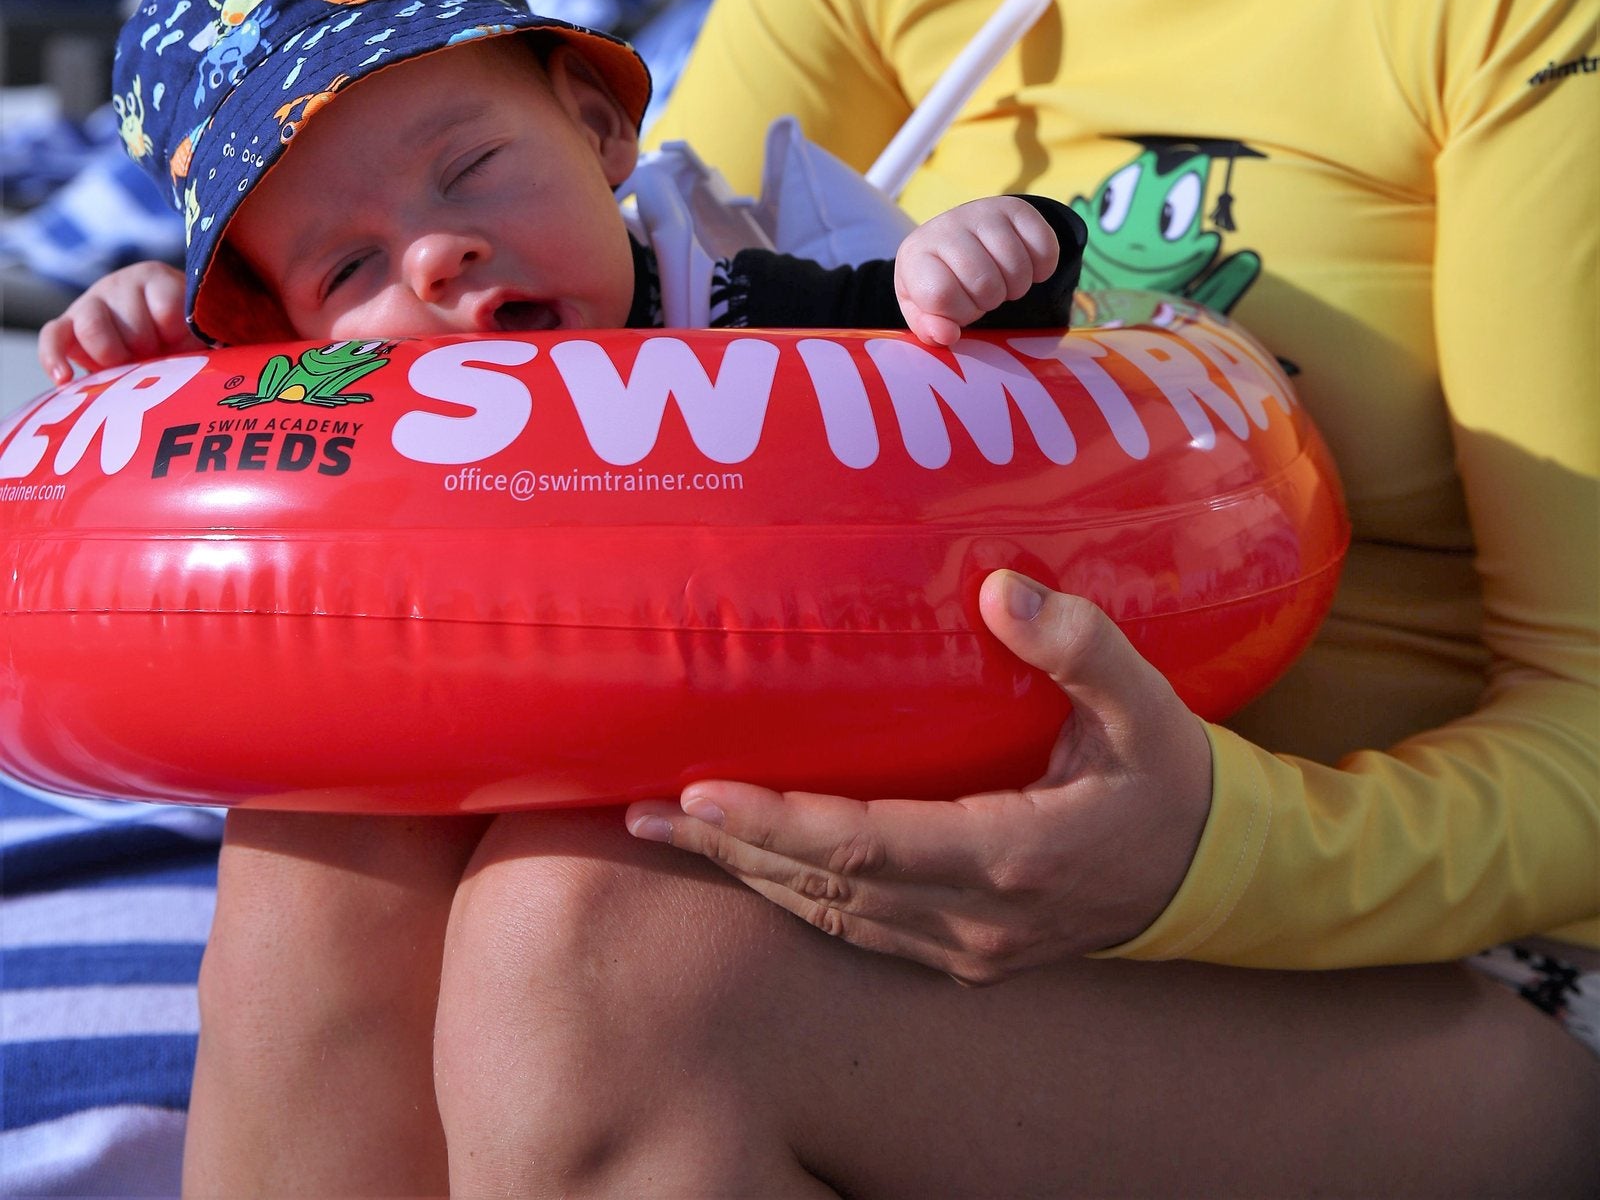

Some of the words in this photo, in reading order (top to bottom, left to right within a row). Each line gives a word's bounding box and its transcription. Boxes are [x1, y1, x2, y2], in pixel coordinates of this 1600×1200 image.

[391, 324, 1297, 469] SWIMTRA
[207, 417, 257, 433] SWIM
[264, 417, 365, 436] ACADEMY
[151, 422, 355, 479] FREDS
[443, 467, 744, 501] office@swimtrainer.com
